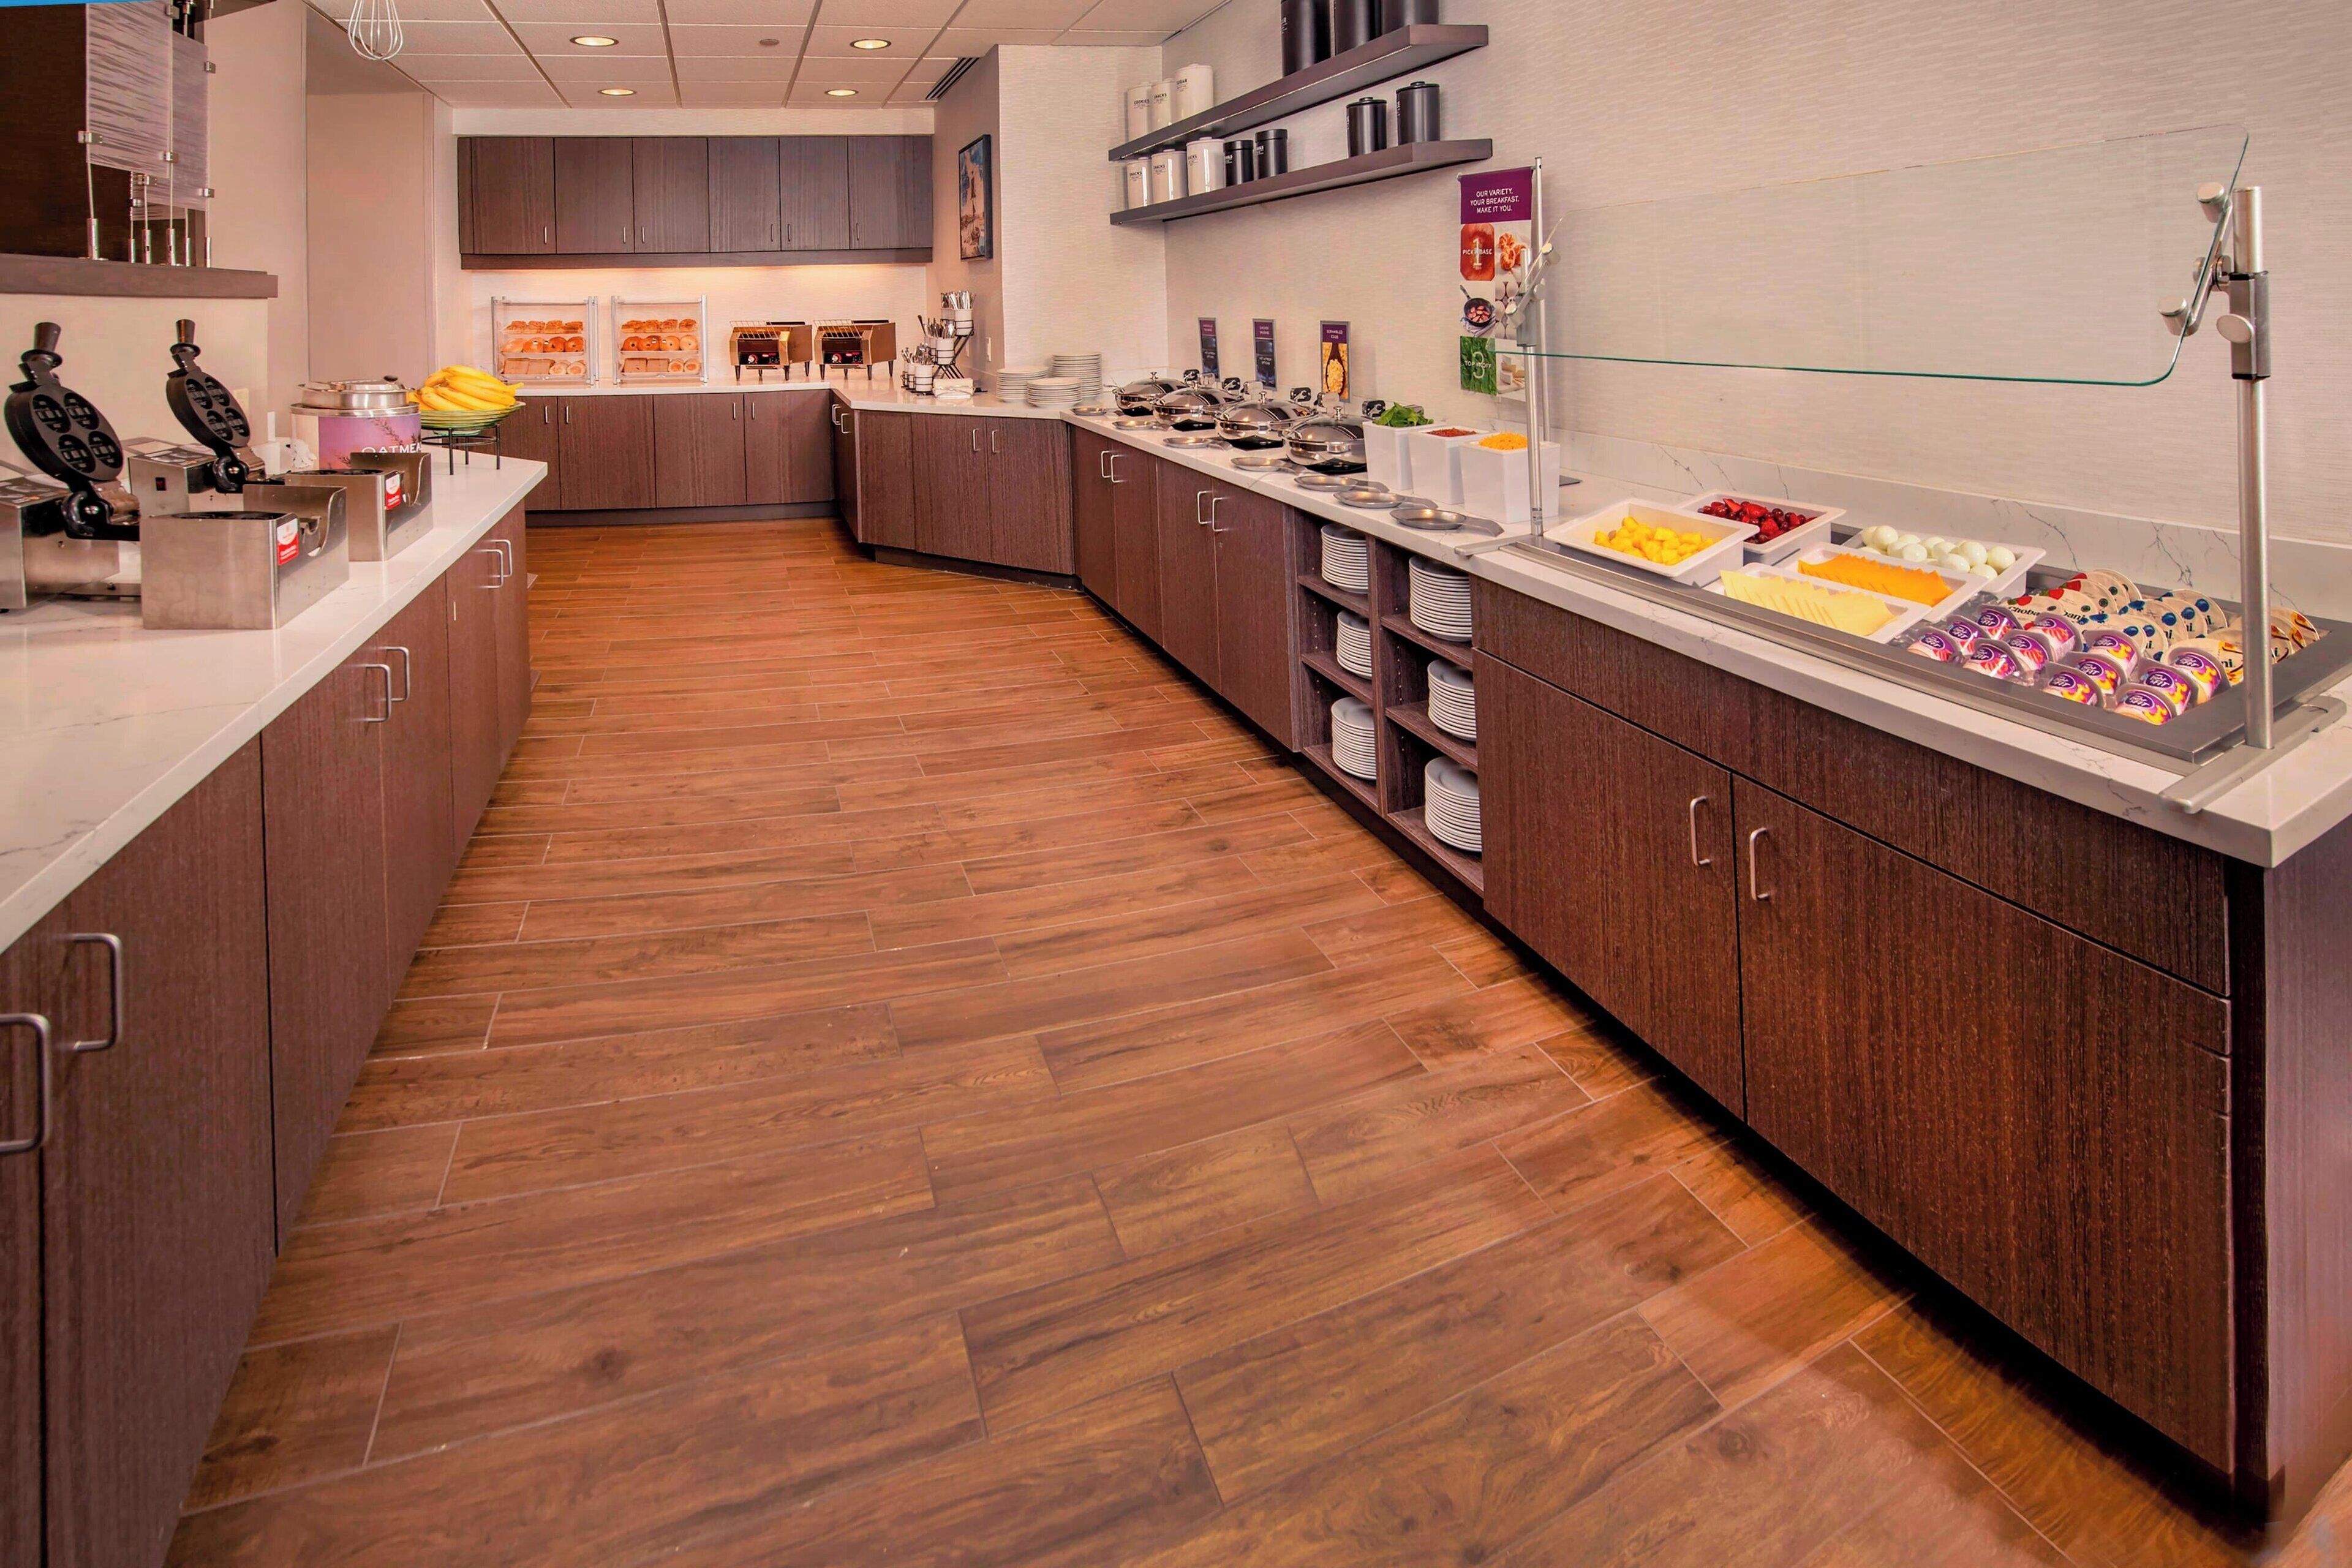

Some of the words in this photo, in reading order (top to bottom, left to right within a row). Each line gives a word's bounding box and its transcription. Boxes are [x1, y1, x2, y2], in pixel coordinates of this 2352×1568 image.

[1489, 187, 1513, 196] VARIETY.
[1486, 195, 1520, 205] BREAKFAST.
[361, 442, 421, 453] OATMEA
